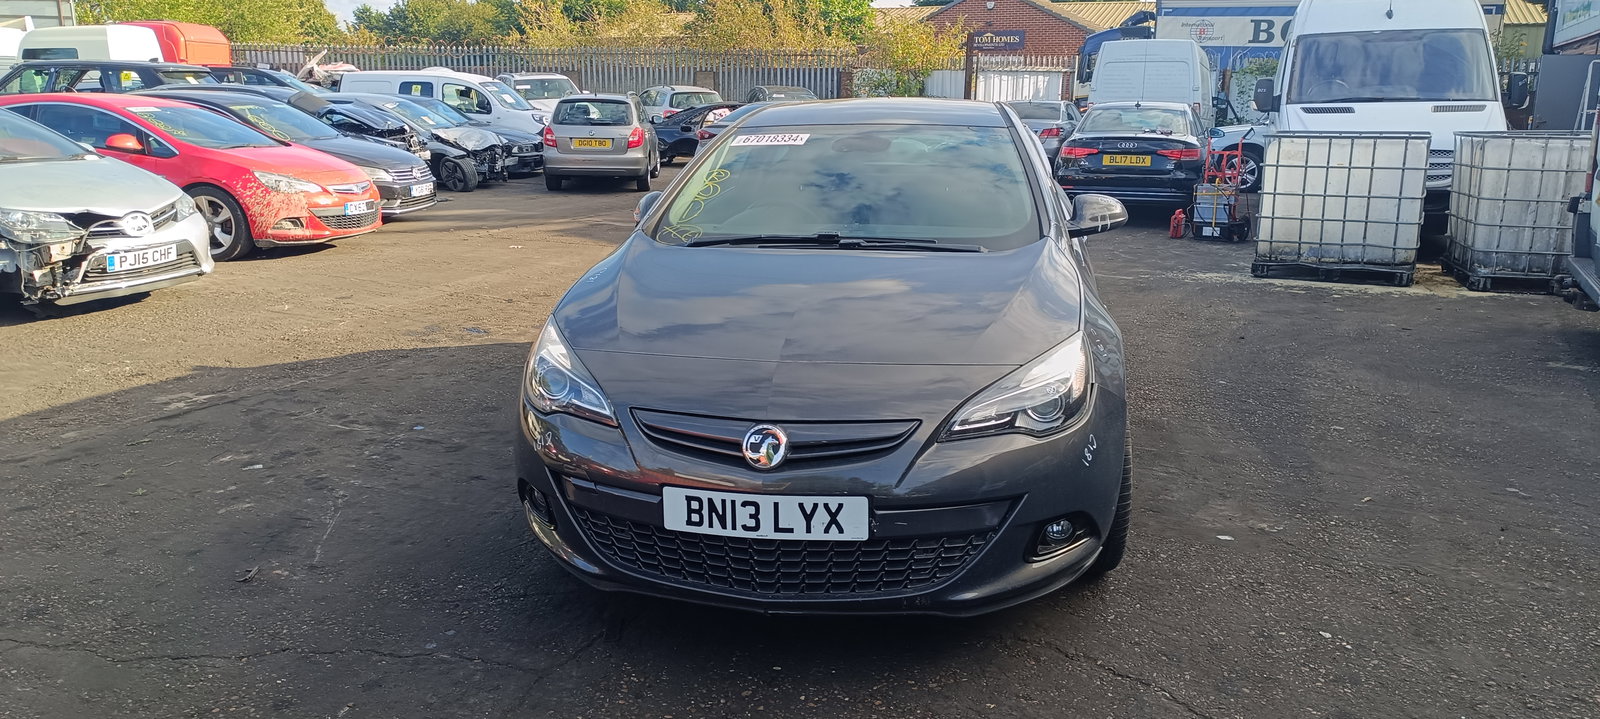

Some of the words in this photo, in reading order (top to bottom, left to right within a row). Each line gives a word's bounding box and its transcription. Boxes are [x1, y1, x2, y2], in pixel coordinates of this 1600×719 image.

[993, 35, 1020, 43] HOMES
[1109, 155, 1128, 164] BL17
[119, 252, 149, 269] PJ15
[152, 246, 173, 262] CHF
[684, 494, 761, 533] BN13
[773, 501, 845, 535] LYX
